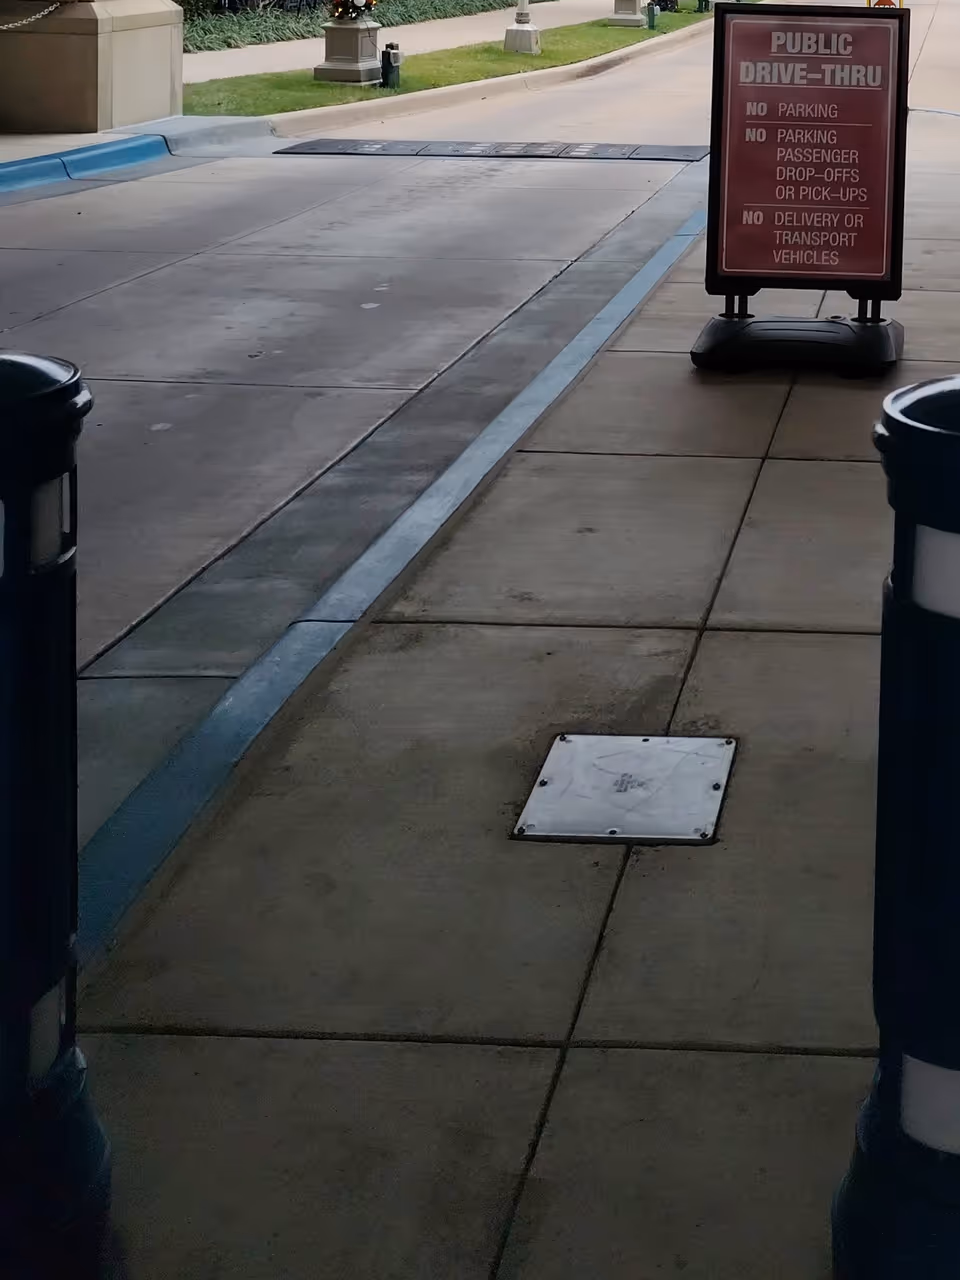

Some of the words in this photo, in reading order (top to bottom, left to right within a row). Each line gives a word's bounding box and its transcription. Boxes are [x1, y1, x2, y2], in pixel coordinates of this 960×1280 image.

[771, 32, 852, 55] PUBLIC
[739, 61, 882, 87] DRIVE-THRU
[746, 102, 767, 116] NO
[778, 103, 838, 118] PARKING
[745, 128, 766, 142] NO
[777, 129, 837, 144] PARKING
[776, 148, 859, 163] PASSENGER
[776, 167, 859, 183] DROP-OFFS
[776, 186, 795, 200] OR
[799, 187, 867, 202] PICK-UPS
[742, 211, 763, 225] NO
[774, 212, 840, 227] DELIVERY
[844, 213, 863, 228] OR
[773, 231, 857, 247] TRANSPORT
[773, 249, 839, 265] VEHICLES
